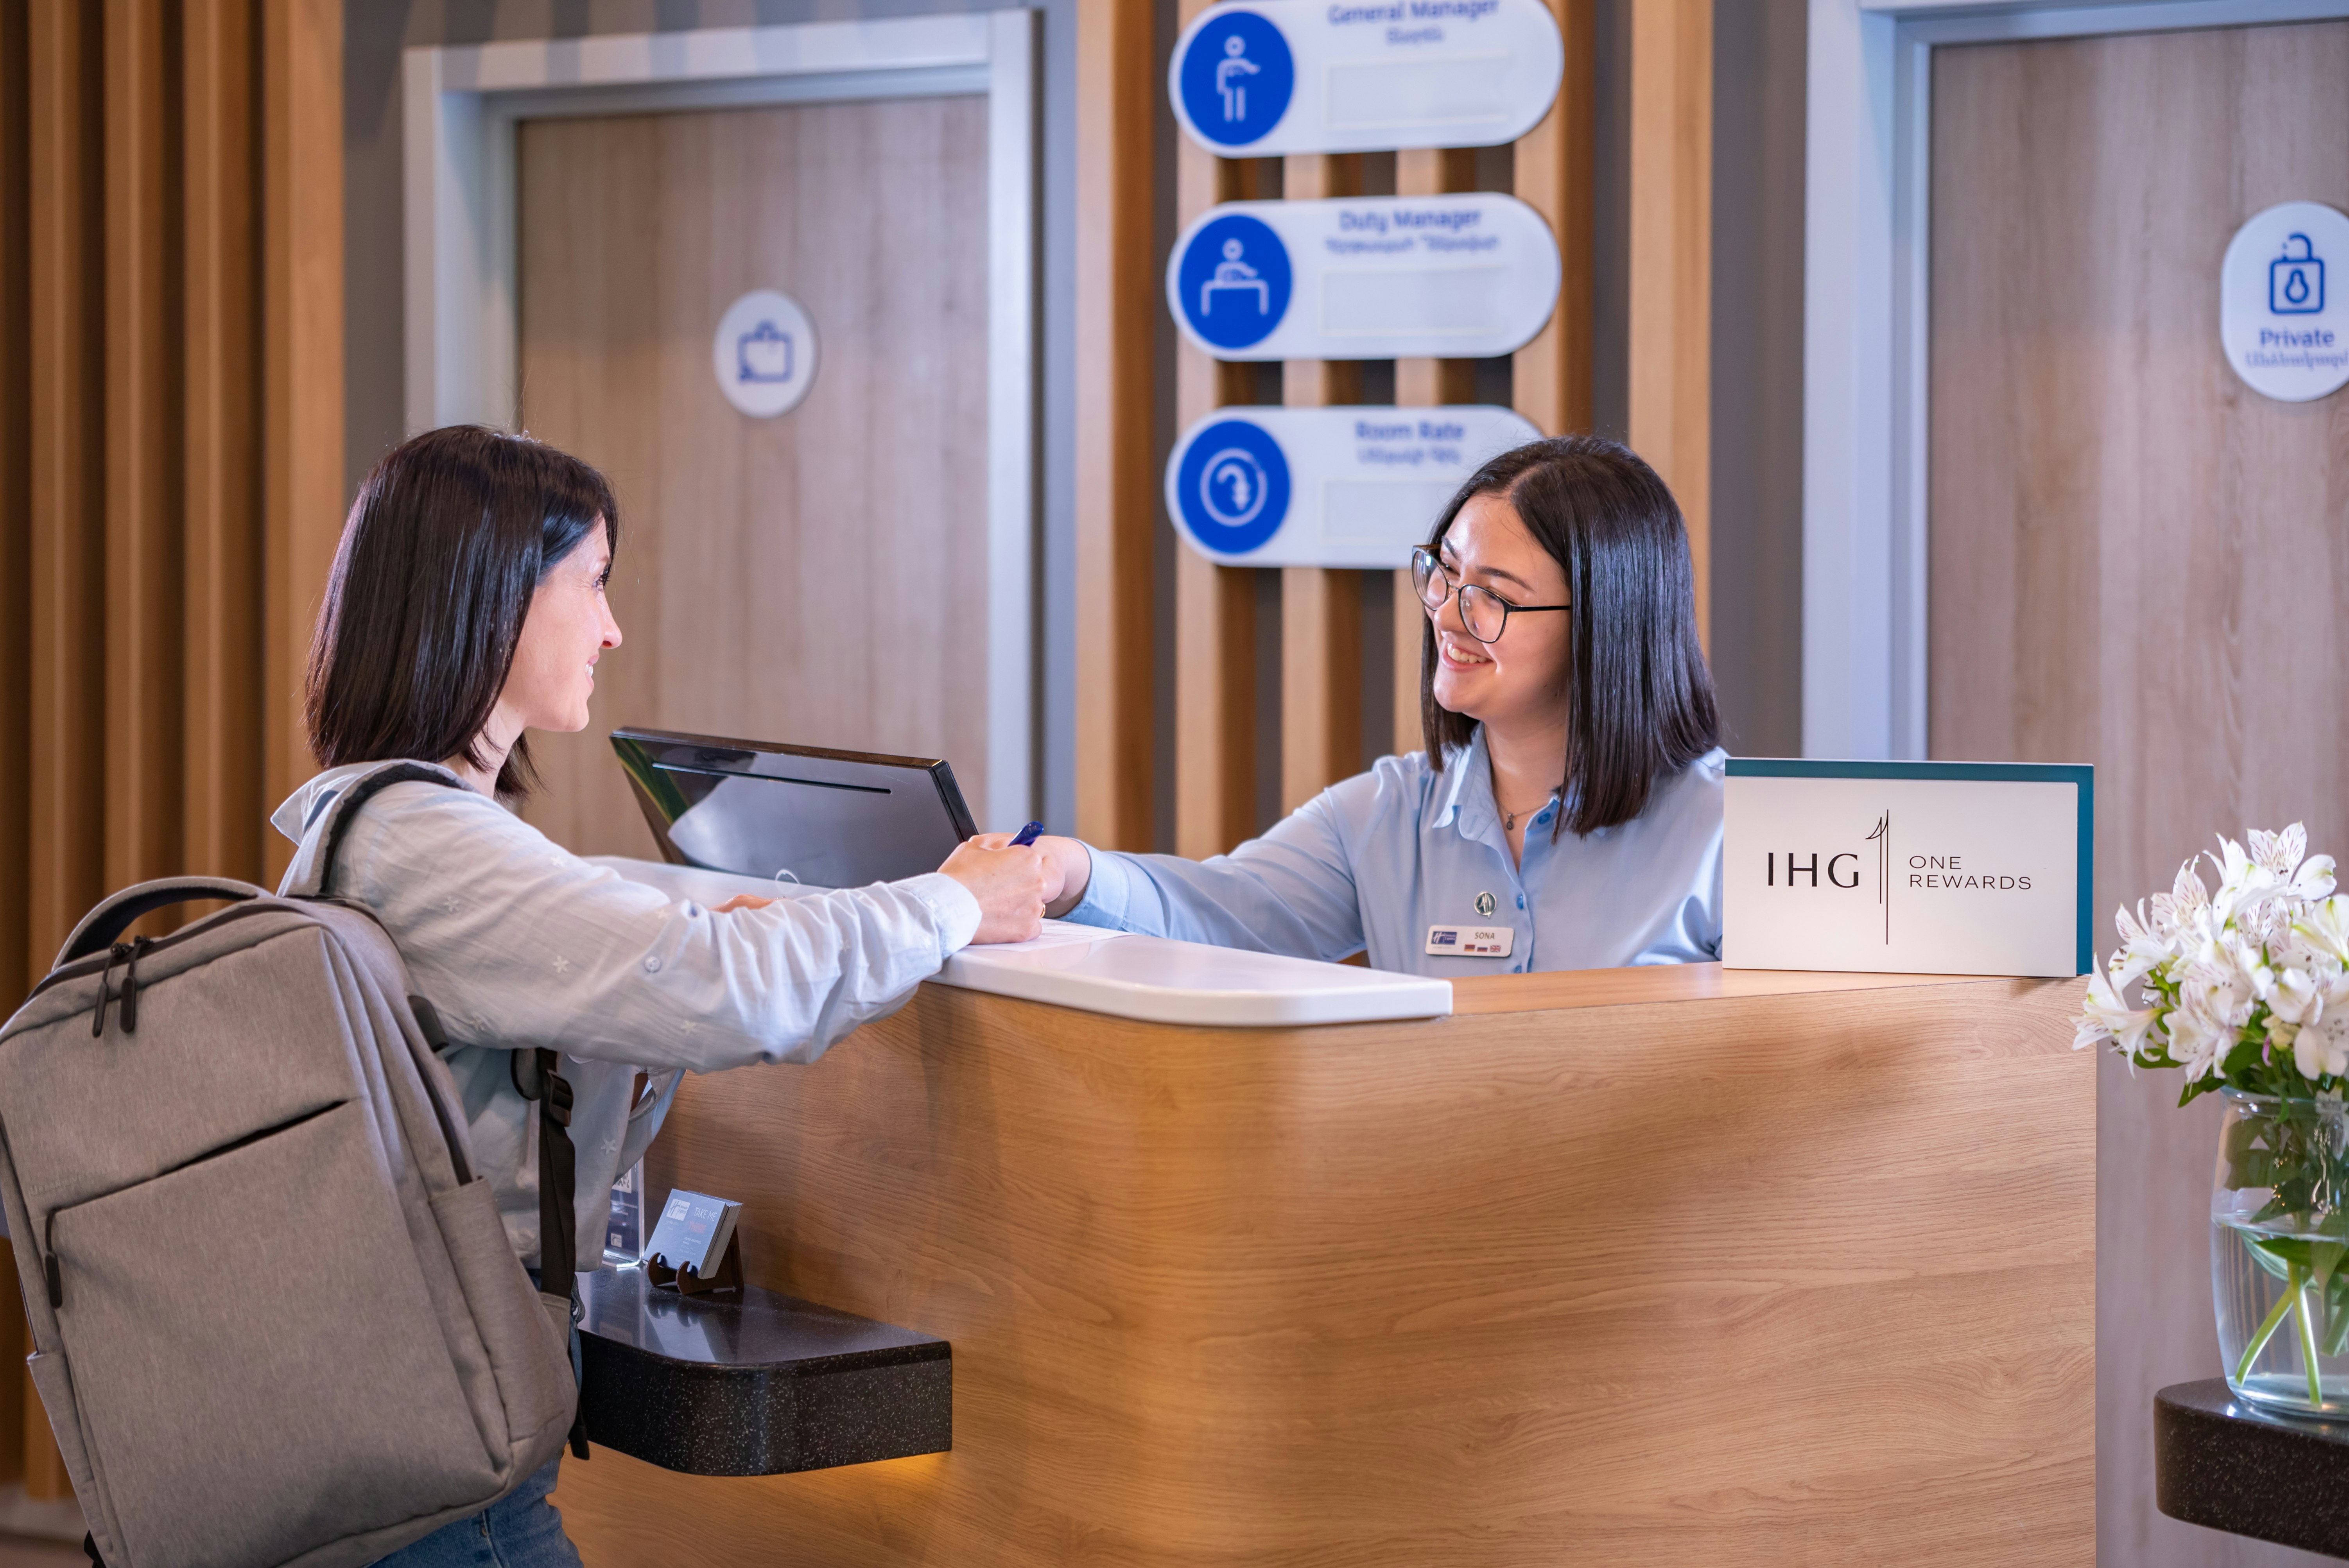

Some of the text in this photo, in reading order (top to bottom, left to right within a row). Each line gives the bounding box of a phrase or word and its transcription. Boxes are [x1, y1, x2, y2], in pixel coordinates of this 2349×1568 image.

[1393, 210, 1481, 233] Manager
[2260, 329, 2335, 348] Private
[1768, 852, 1859, 888] IHG
[1909, 855, 1961, 869] ONE
[1910, 874, 2032, 890] REWARDS
[694, 1207, 708, 1219] TAKE
[707, 1210, 717, 1222] ME
